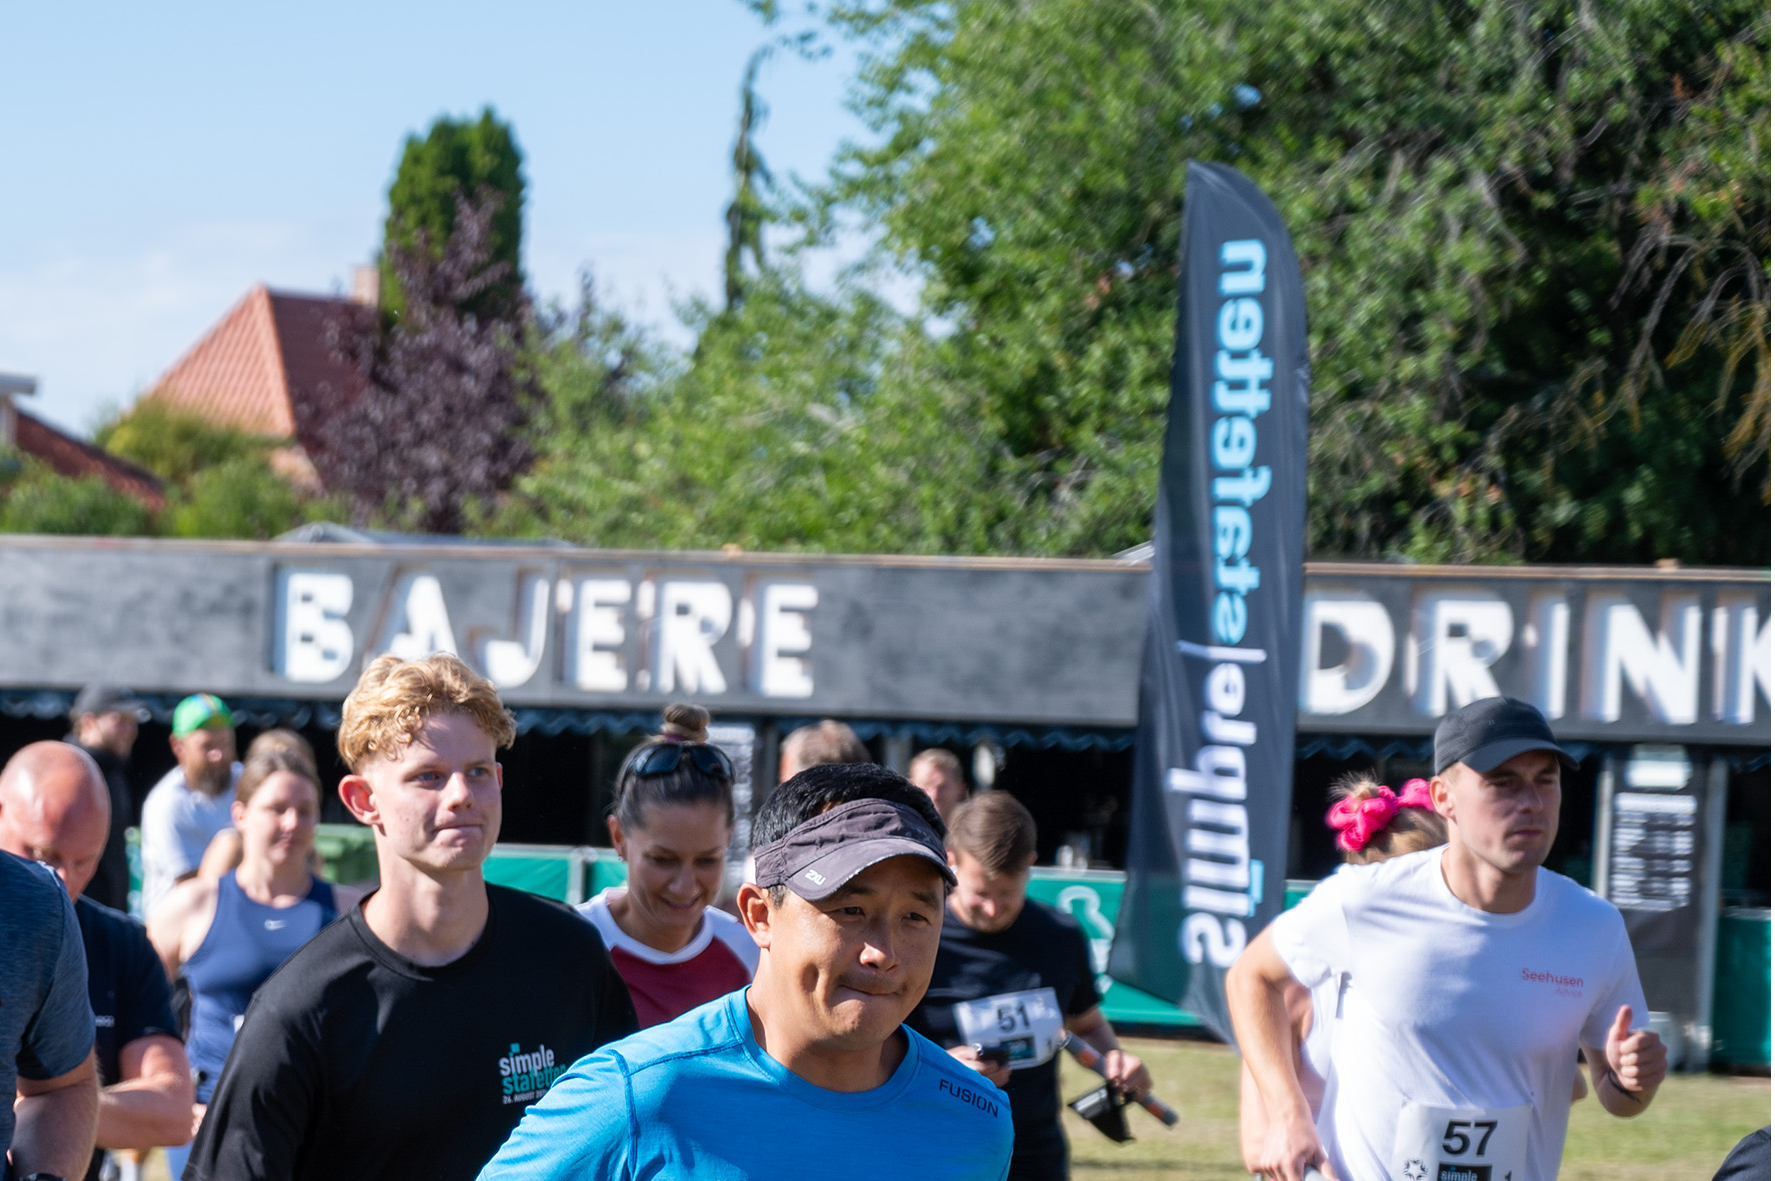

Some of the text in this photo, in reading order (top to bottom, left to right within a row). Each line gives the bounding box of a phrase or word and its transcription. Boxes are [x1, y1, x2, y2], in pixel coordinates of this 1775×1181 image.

[283, 572, 818, 698] BAJERE
[805, 869, 826, 886] 2XU
[1521, 967, 1584, 988] Seehusen
[997, 1002, 1029, 1031] 51
[499, 1043, 555, 1077] simple
[939, 1079, 999, 1118] FUSION
[1442, 1119, 1498, 1157] 57
